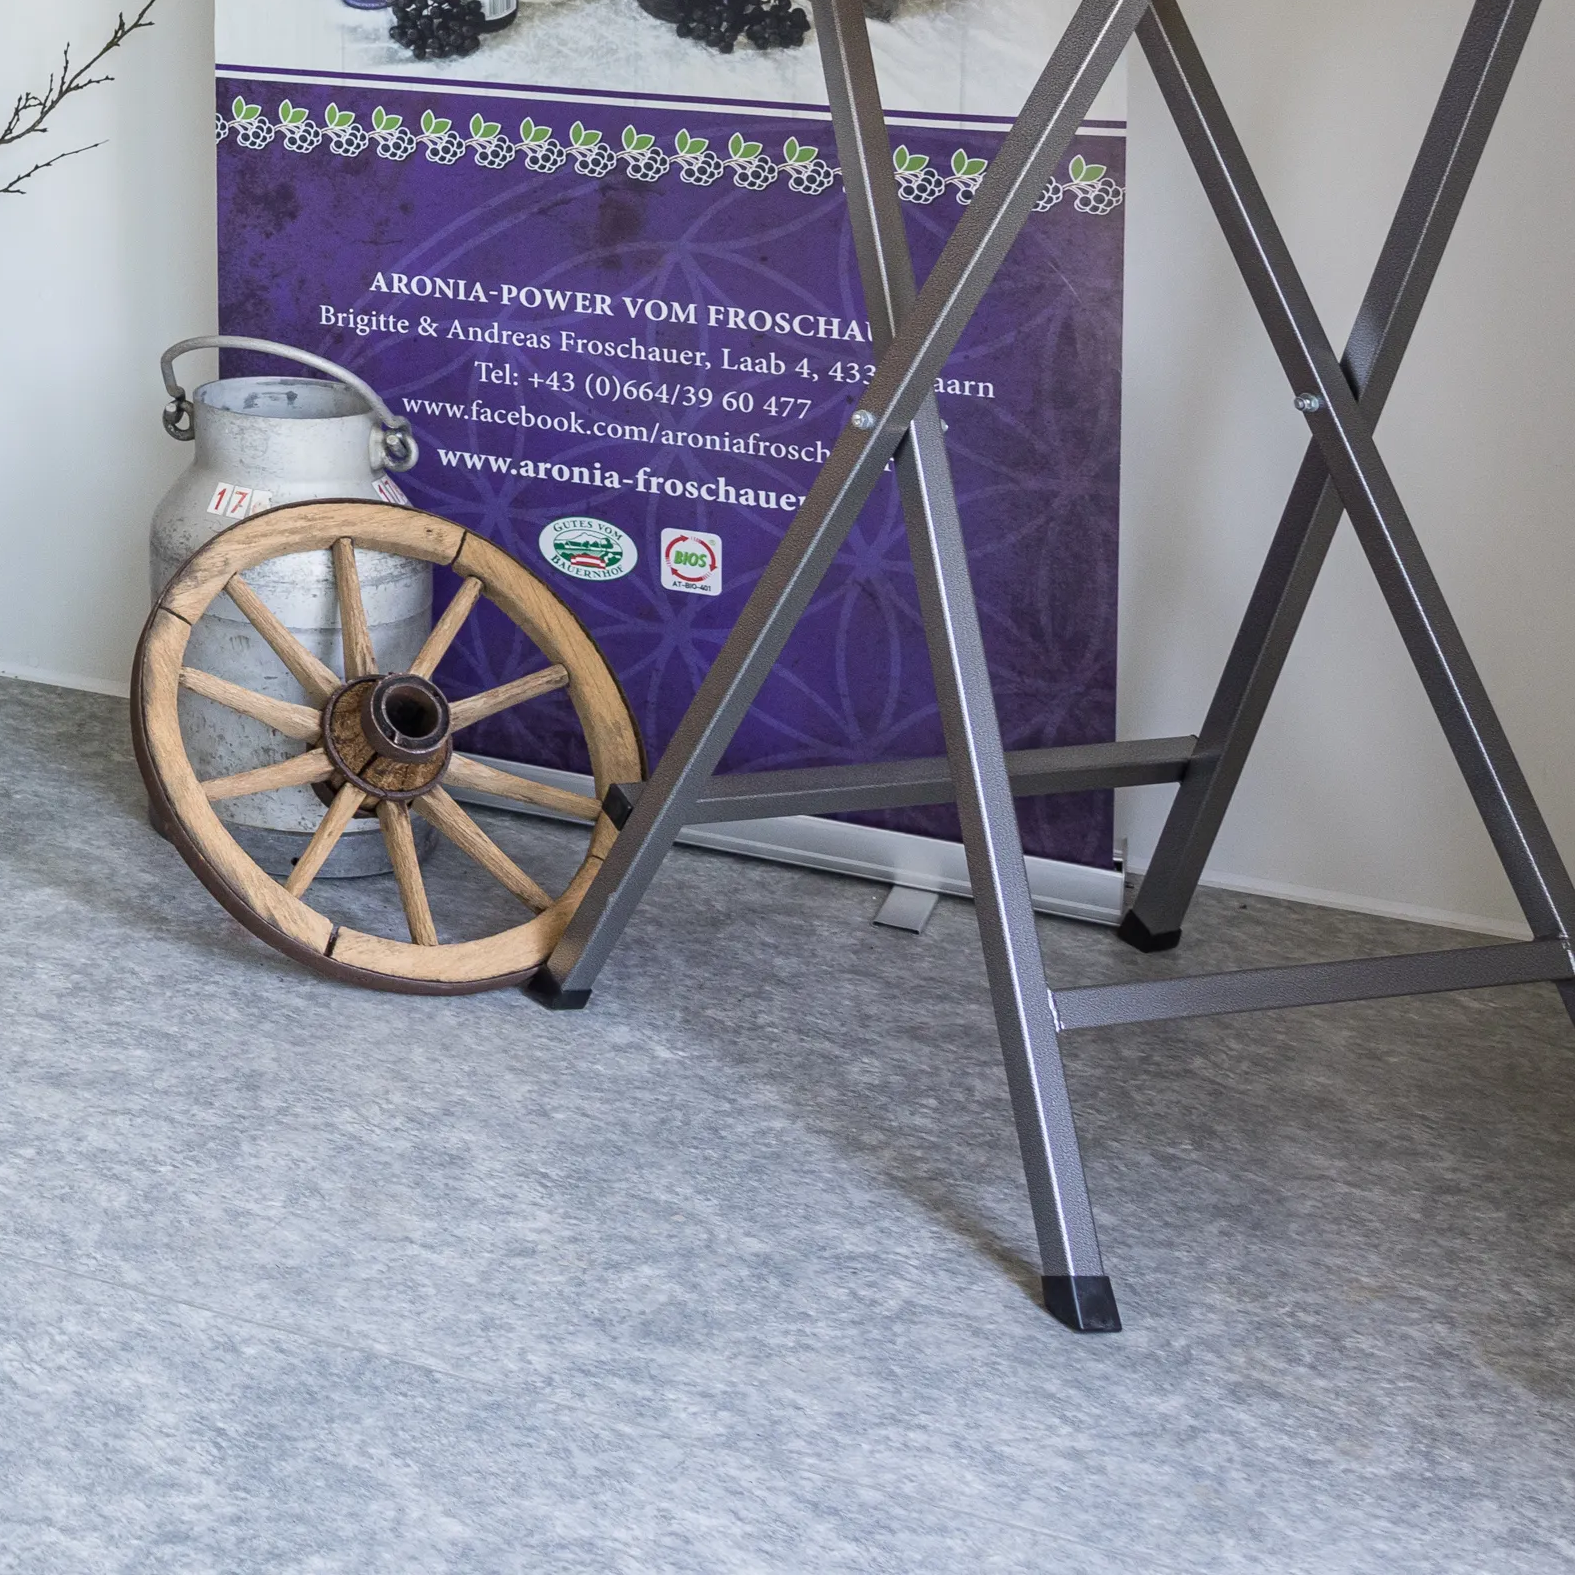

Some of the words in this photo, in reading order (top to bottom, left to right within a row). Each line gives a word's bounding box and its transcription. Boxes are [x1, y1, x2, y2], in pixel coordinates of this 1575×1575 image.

[369, 271, 614, 317] ARONIA-POWER
[622, 296, 698, 325] VOM
[319, 305, 409, 335] Brigitte
[418, 316, 439, 337] &
[446, 320, 550, 349] Andreas
[560, 331, 711, 370] Froschauer,
[721, 349, 786, 375] Laab
[795, 358, 819, 381] 4,
[829, 362, 876, 385] 433
[934, 378, 995, 398] aarn
[474, 361, 518, 386] Tel:
[528, 372, 575, 392] +43
[584, 373, 713, 407] (0)664/39
[723, 392, 753, 413] 60
[763, 396, 812, 418] 477
[554, 520, 593, 533] GUTES
[598, 523, 622, 541] VOM
[551, 555, 624, 579] BAUERNHOF
[674, 550, 707, 568] BIOS
